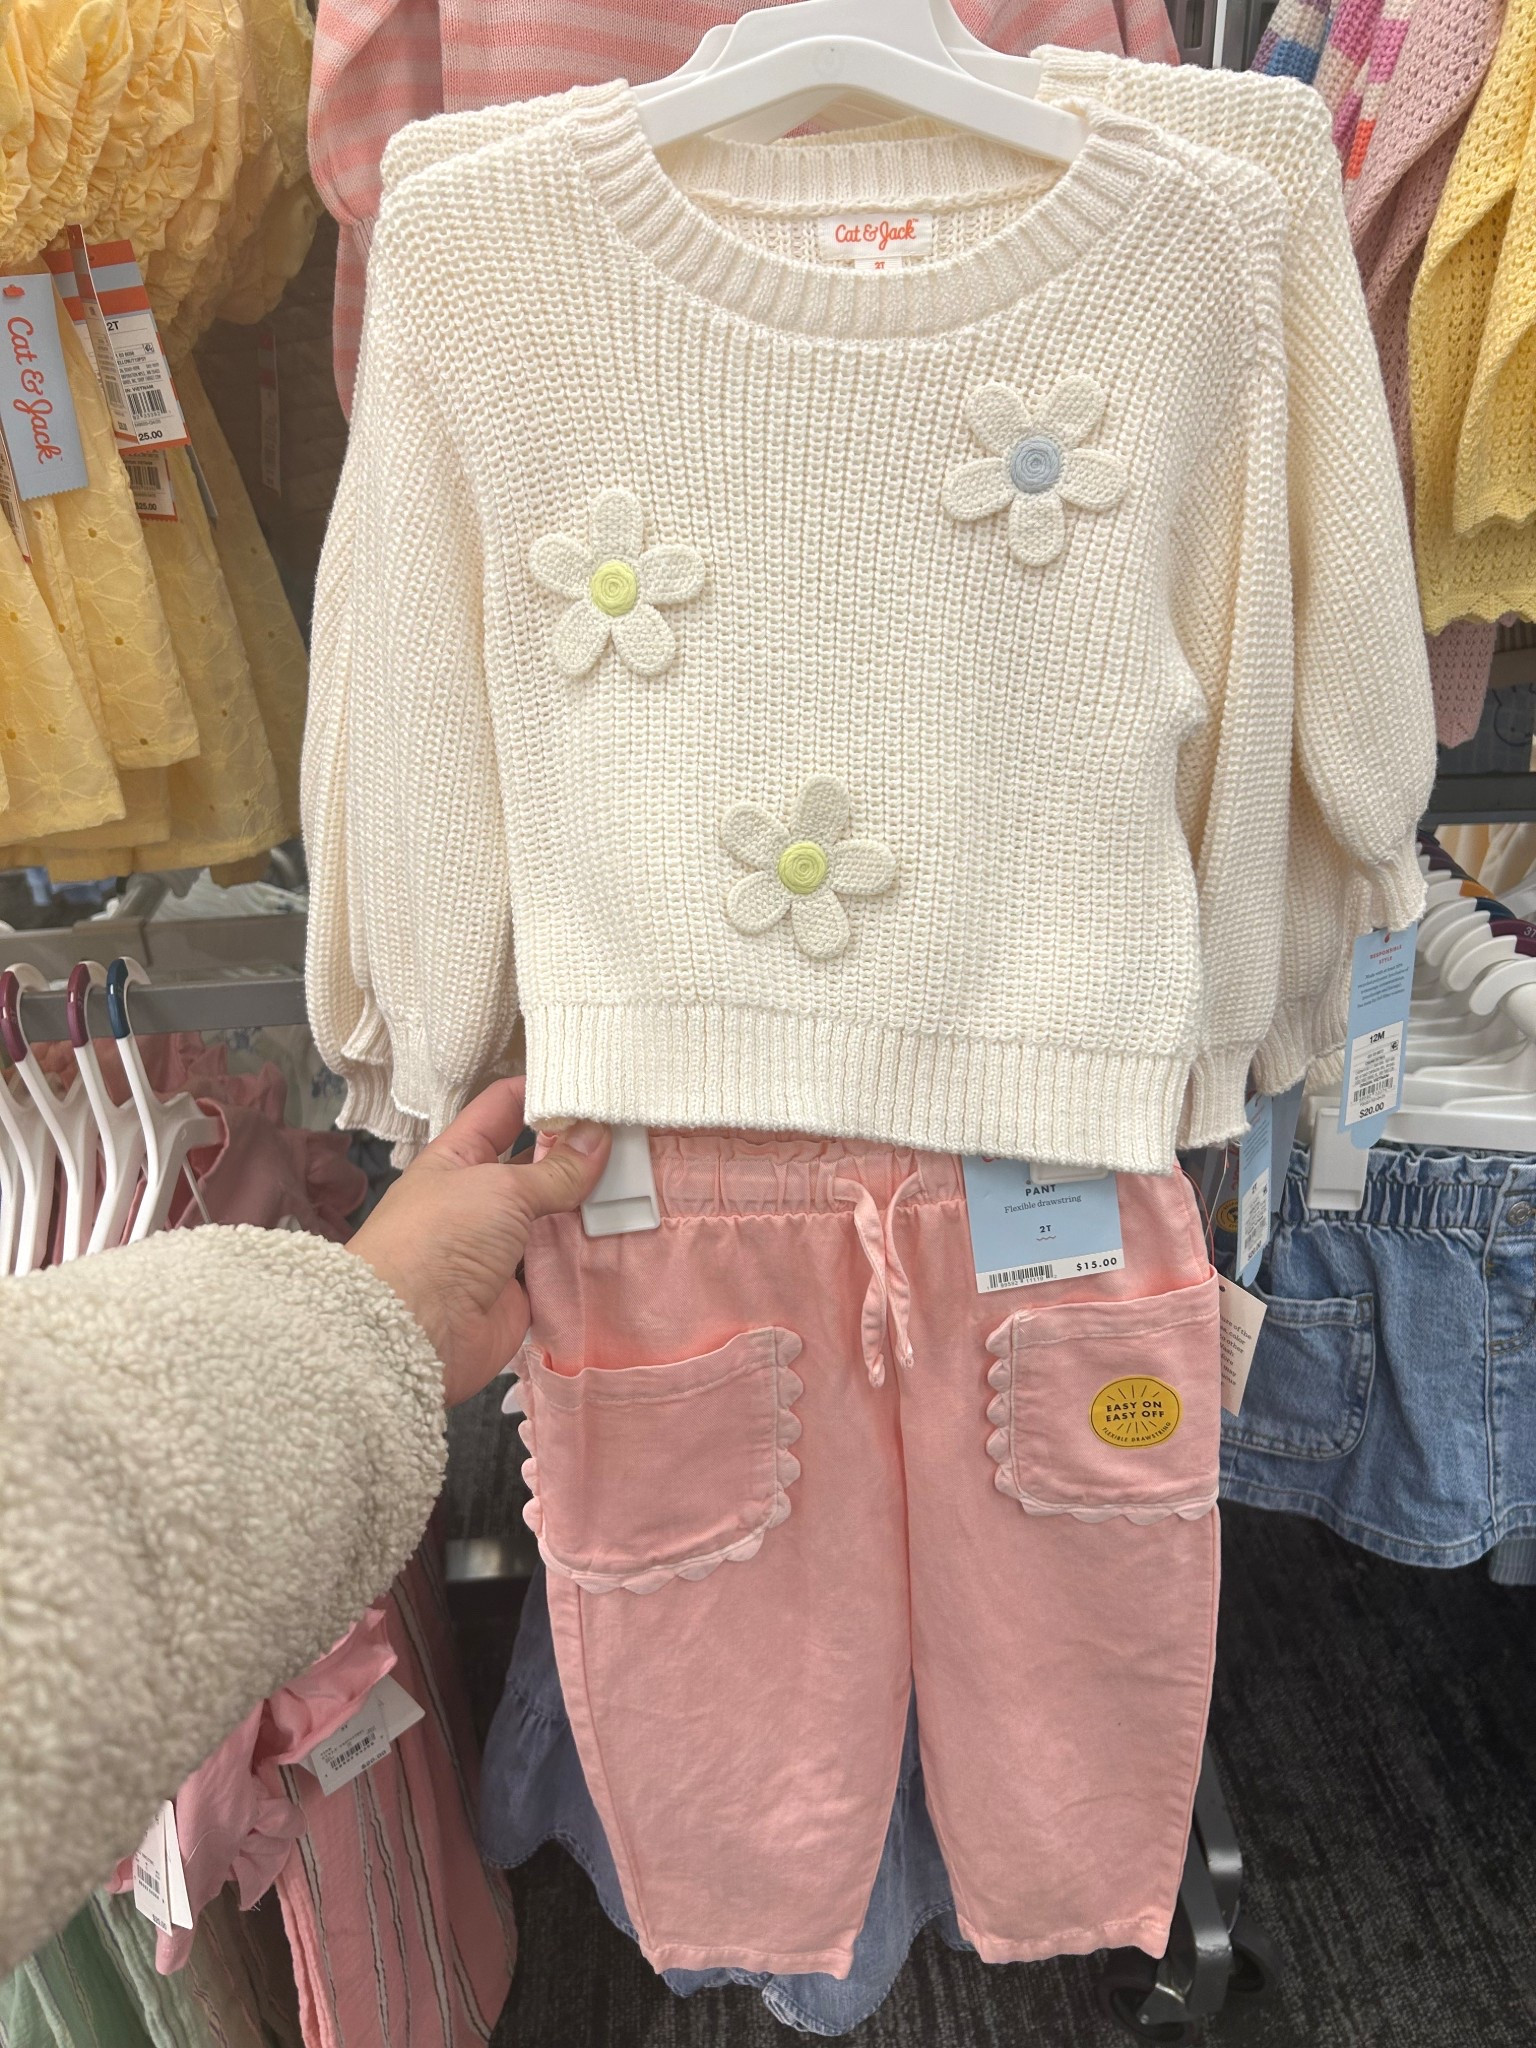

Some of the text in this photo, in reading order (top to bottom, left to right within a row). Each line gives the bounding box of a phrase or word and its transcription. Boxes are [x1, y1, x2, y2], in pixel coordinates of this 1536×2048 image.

[835, 224, 861, 243] Cat
[863, 223, 878, 241] &
[874, 261, 885, 269] 2T
[107, 321, 119, 331] 2T
[7, 316, 62, 464] Cat & Jack
[138, 430, 163, 441] 25.00
[1370, 944, 1402, 959] RESPONSIBLE
[1369, 1031, 1385, 1044] 12M
[1359, 1102, 1385, 1118] $20.00
[1025, 1184, 1057, 1196] PANT
[1004, 1195, 1082, 1214] Flexible drawstring
[1039, 1225, 1052, 1233] 2T
[1076, 1257, 1118, 1271] $15.00
[1106, 1402, 1137, 1412] EASY
[1106, 1410, 1165, 1422] EASY OFF
[1102, 1421, 1171, 1442] FLEXIBLE DRAWSTRING
